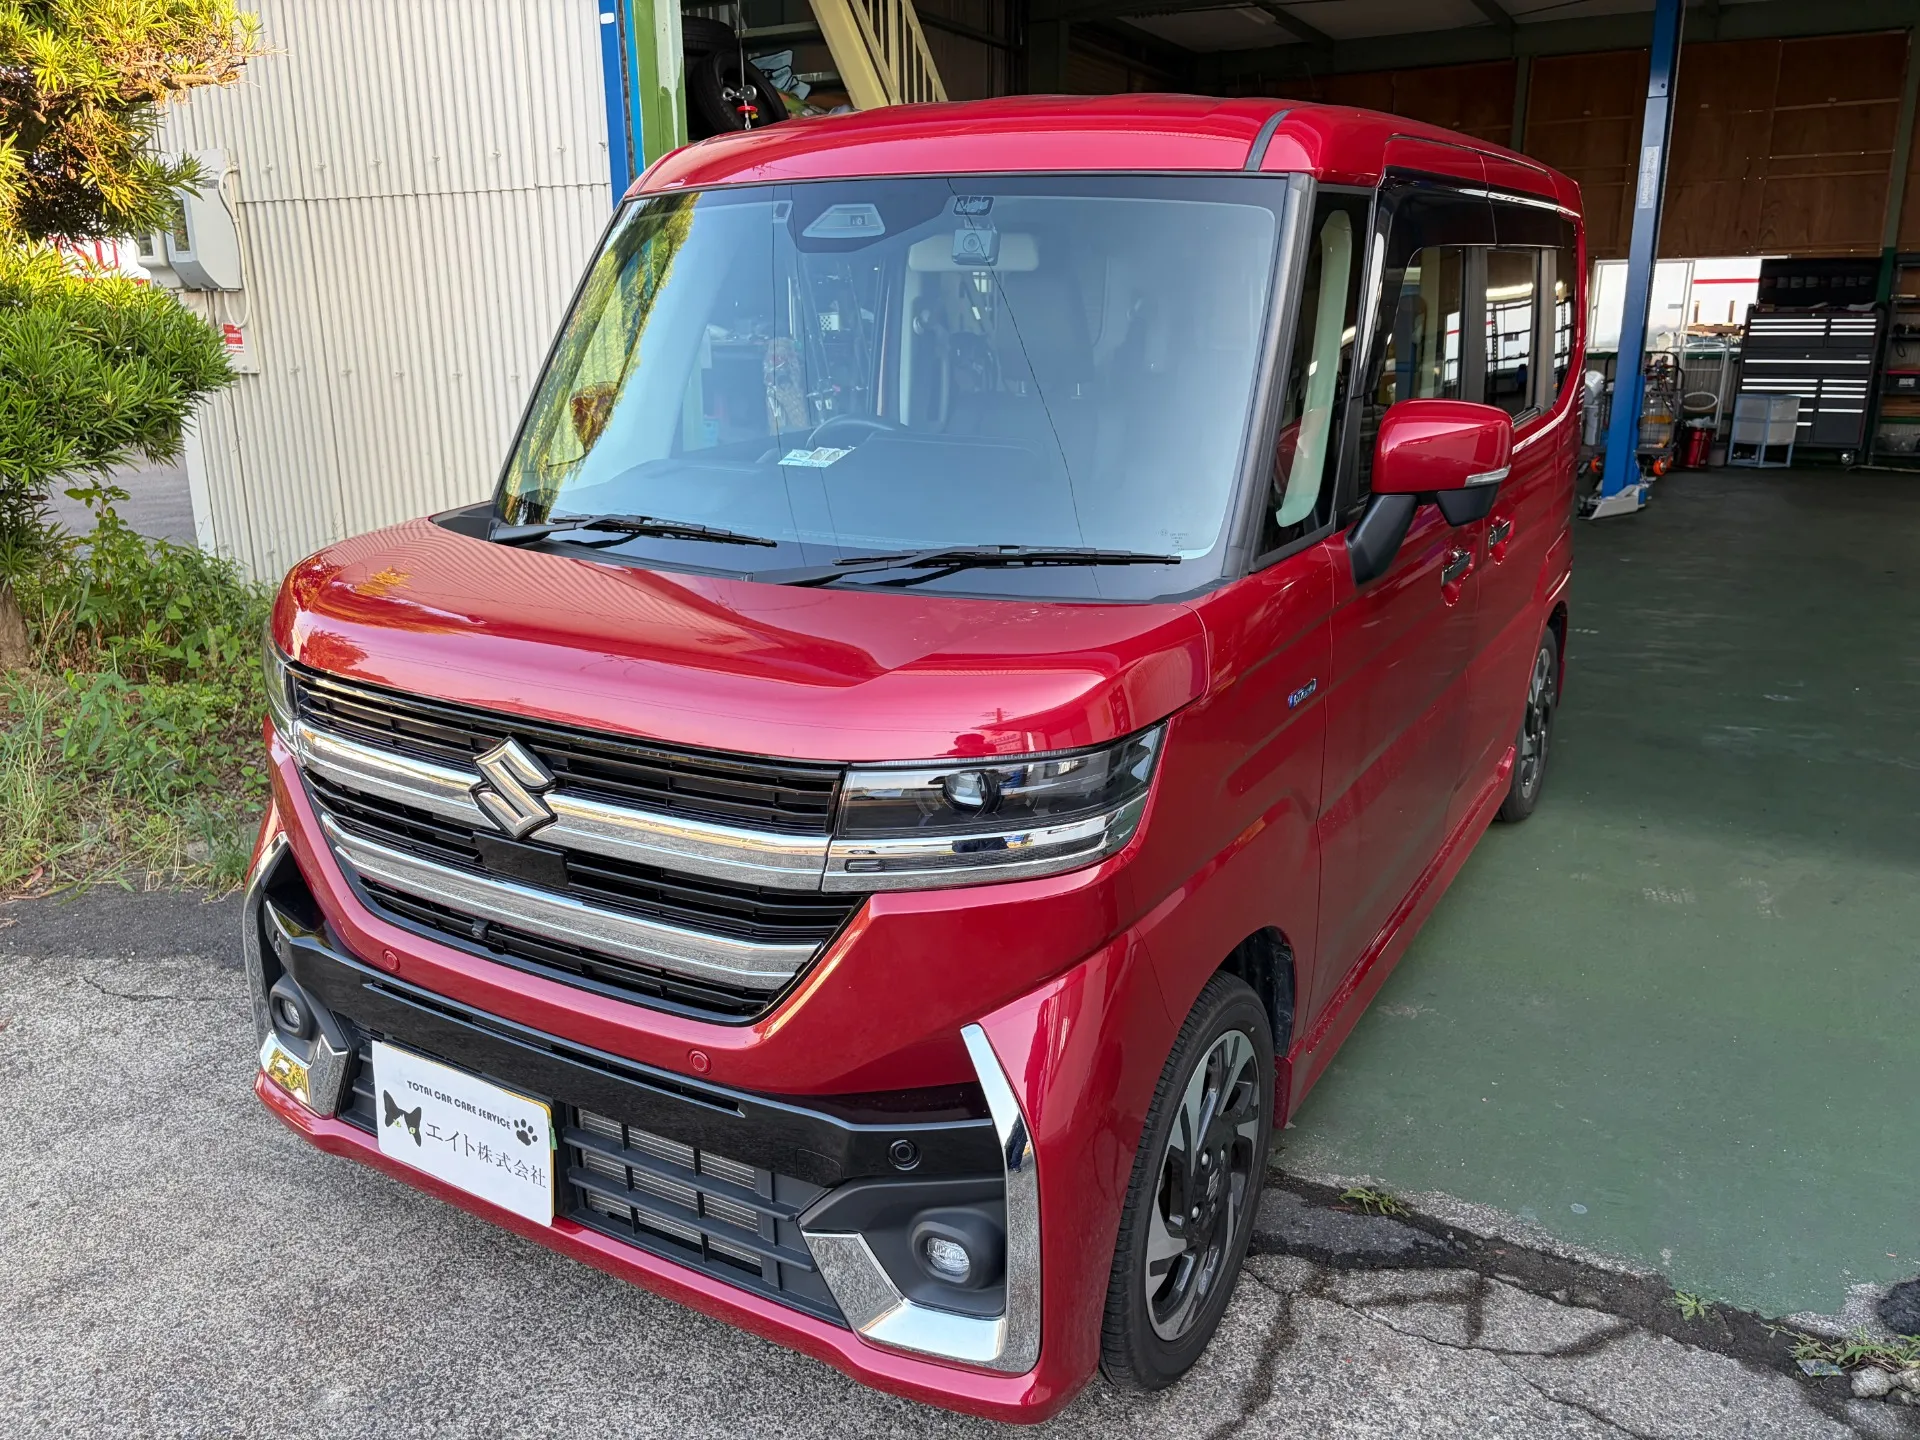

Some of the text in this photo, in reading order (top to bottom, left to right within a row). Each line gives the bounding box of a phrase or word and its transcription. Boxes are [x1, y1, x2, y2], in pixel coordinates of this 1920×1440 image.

[406, 1080, 511, 1131] TOTAL CAR CARE SERVICE
[425, 1122, 547, 1189] エイト株式会社
